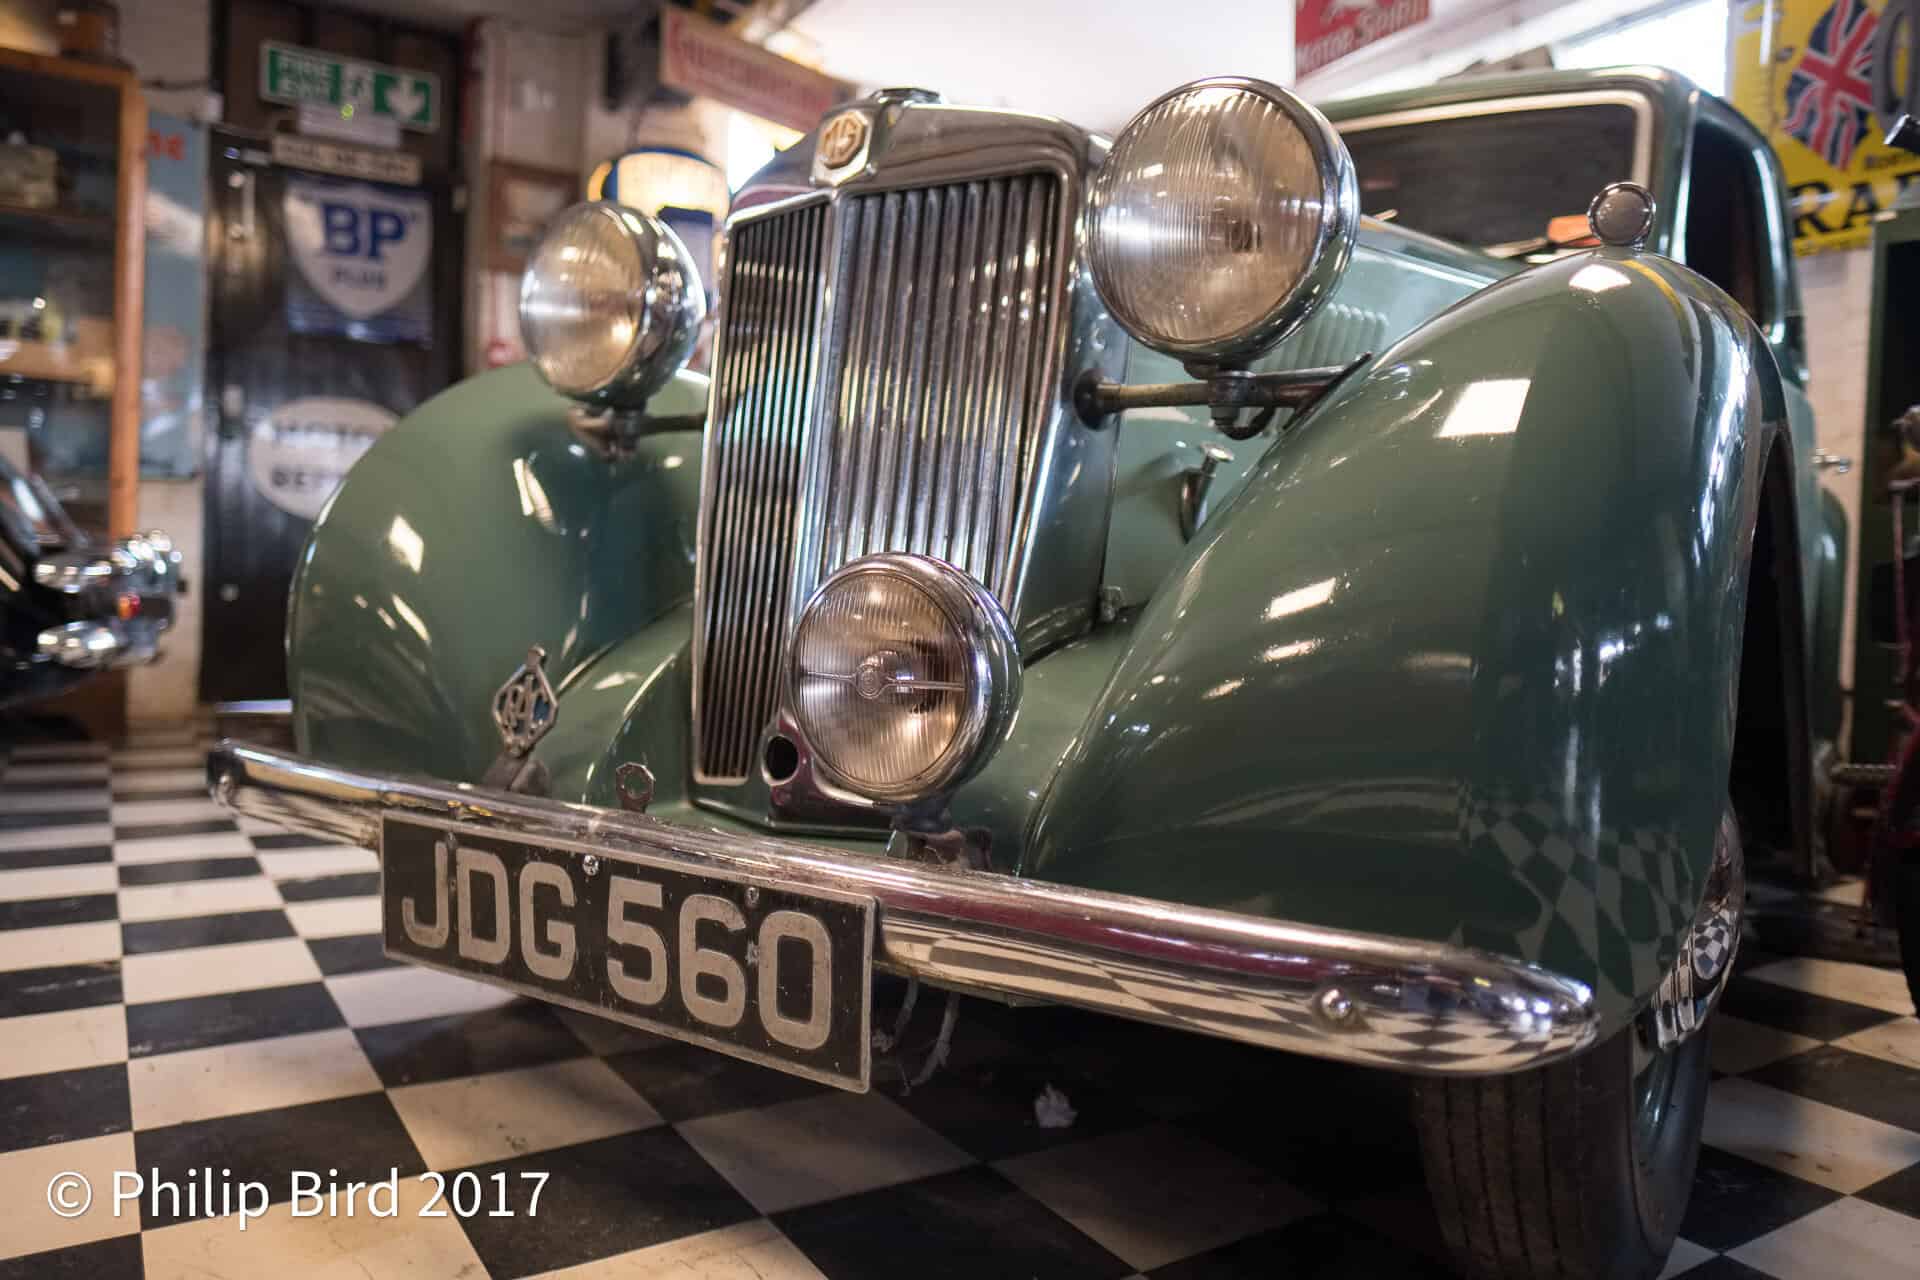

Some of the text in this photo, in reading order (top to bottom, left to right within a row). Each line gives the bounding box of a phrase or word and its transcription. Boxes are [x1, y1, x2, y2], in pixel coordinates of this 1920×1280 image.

[322, 202, 406, 260] BP
[402, 841, 832, 1050] JDG 560
